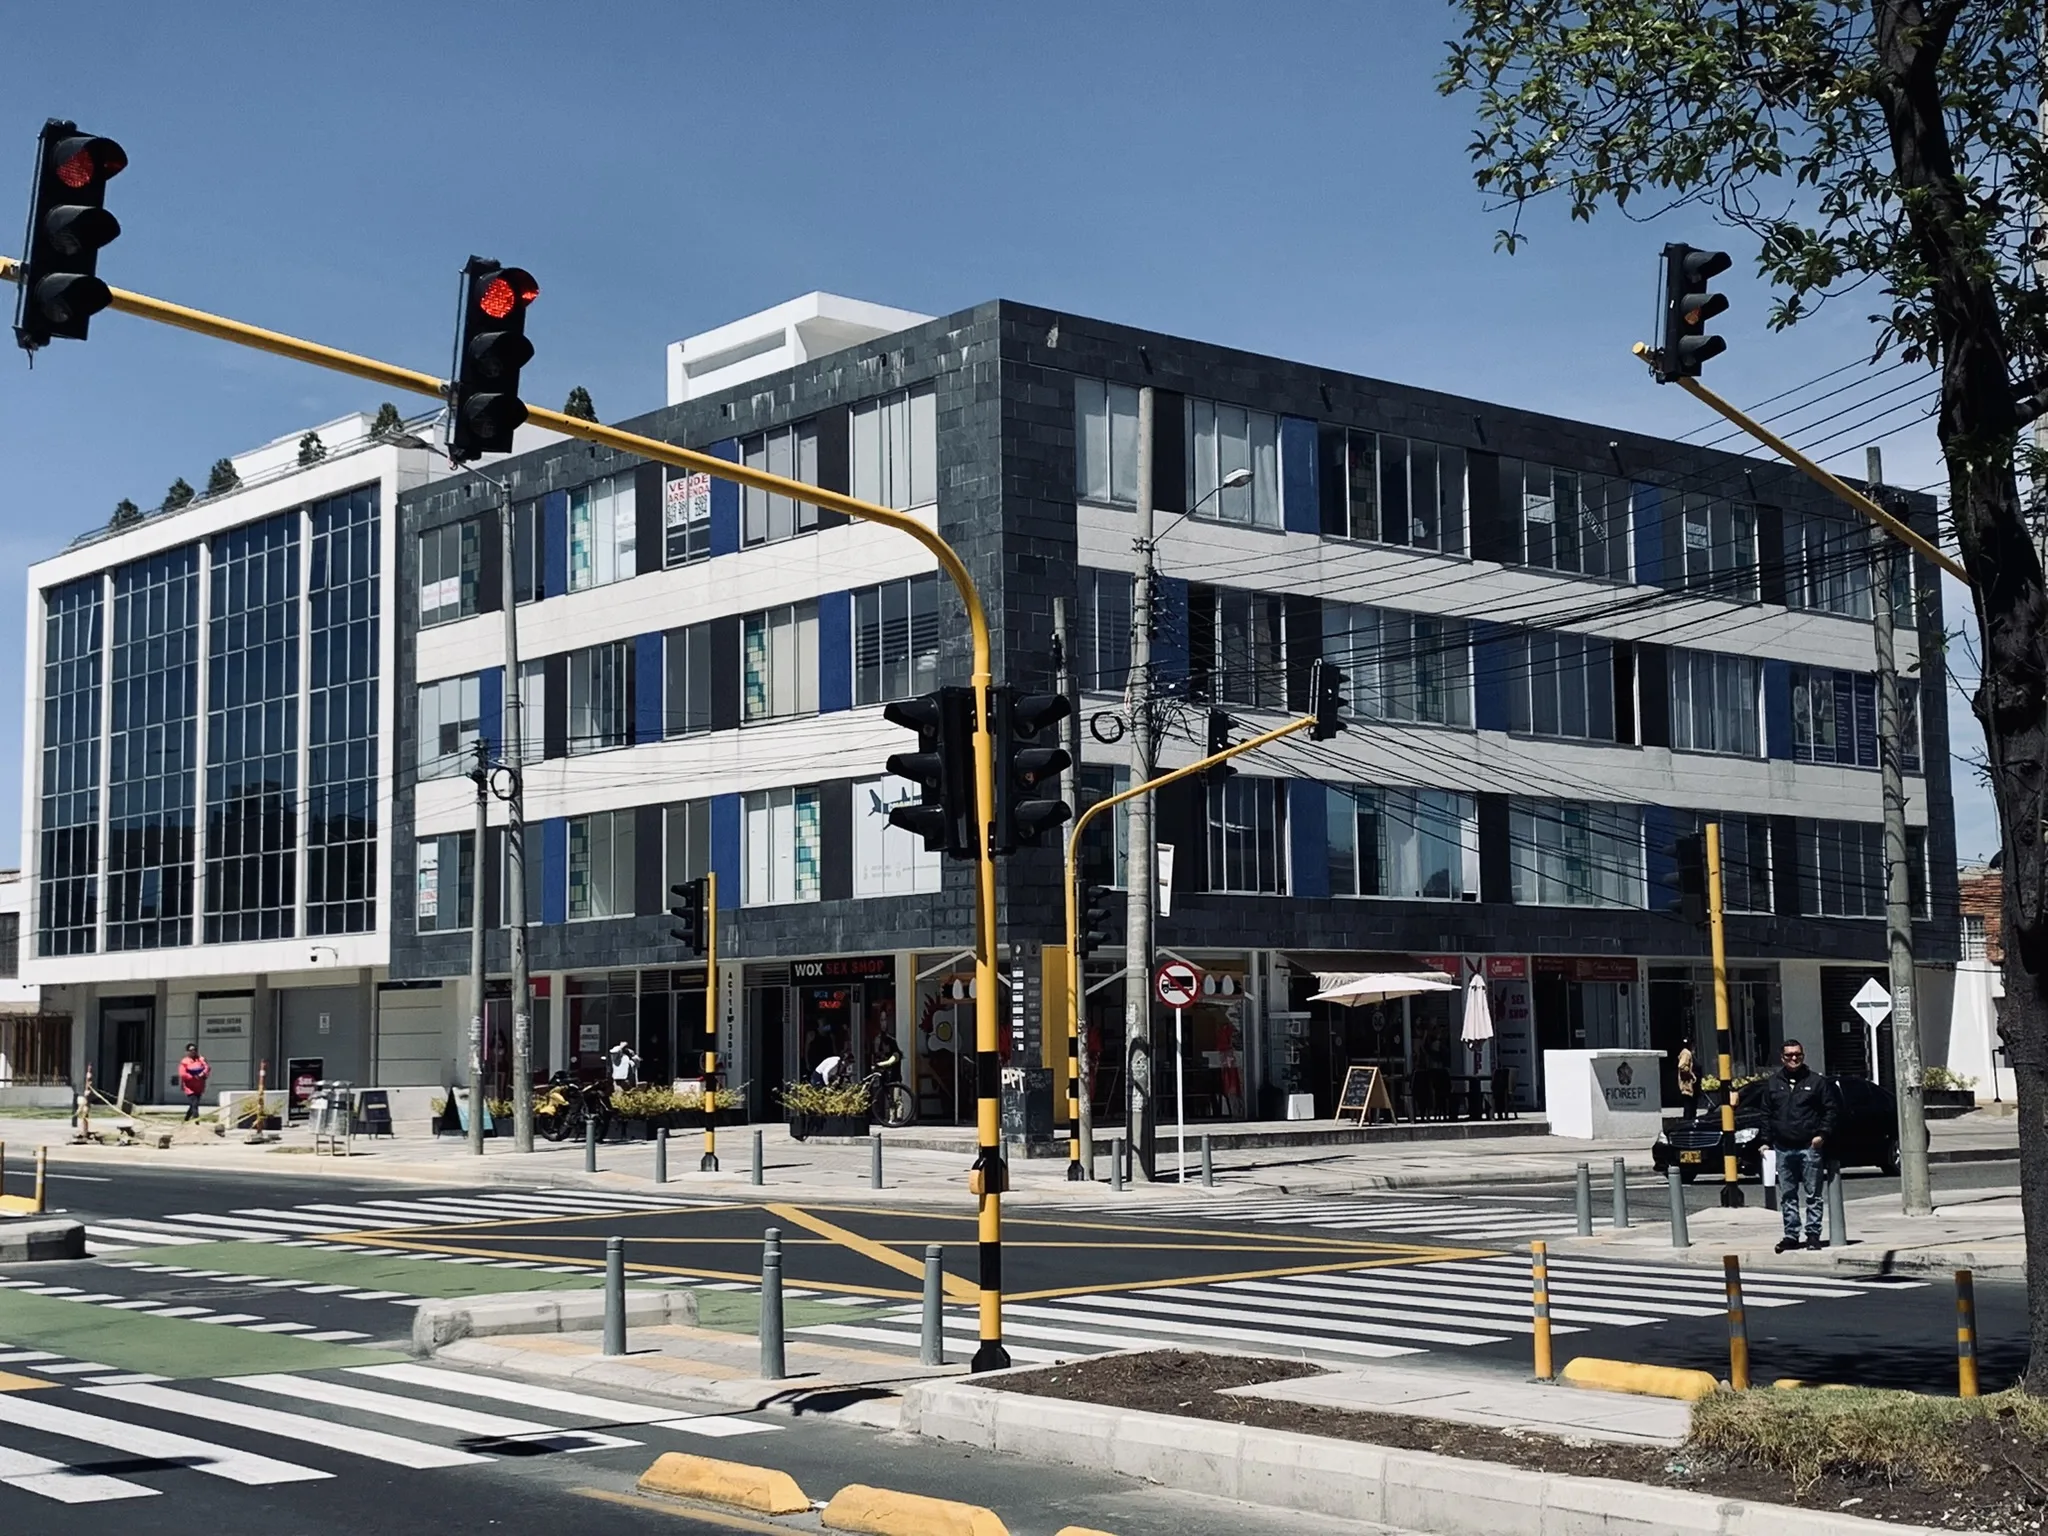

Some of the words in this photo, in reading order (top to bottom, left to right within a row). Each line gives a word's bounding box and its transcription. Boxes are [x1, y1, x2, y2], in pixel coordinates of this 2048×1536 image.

[669, 475, 709, 492] VENDE
[795, 963, 823, 977] WOX
[826, 961, 848, 975] SEX
[852, 960, 885, 974] SHOP
[1511, 994, 1525, 1005] SEX
[1509, 1009, 1529, 1020] SHOP
